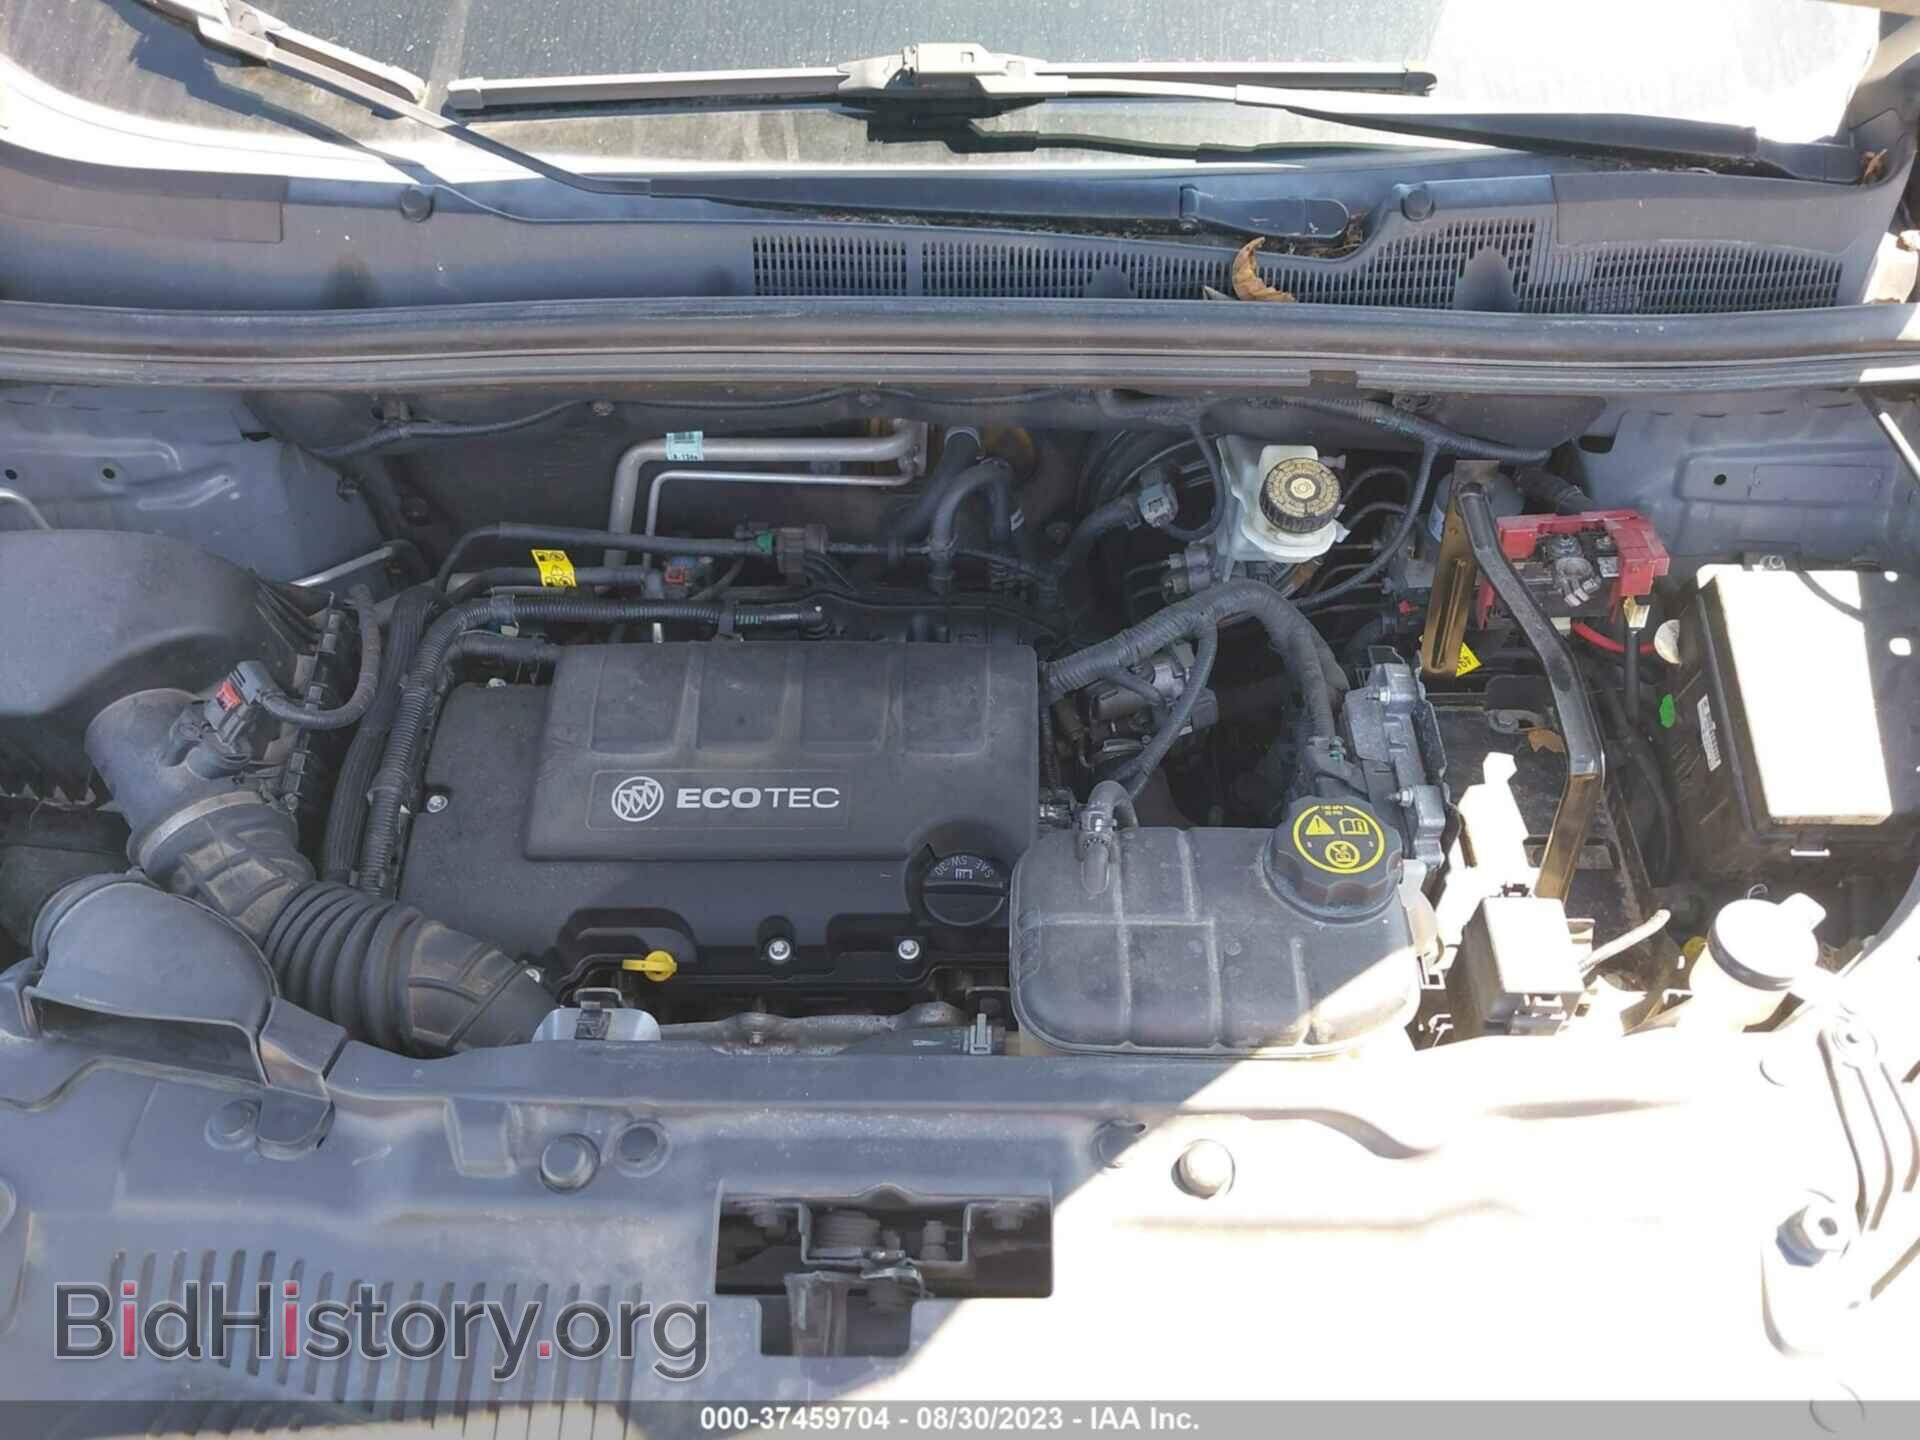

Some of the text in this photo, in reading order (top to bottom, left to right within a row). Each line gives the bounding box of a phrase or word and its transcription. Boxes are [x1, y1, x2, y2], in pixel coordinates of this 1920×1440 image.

[676, 786, 841, 810] ECOTEC
[934, 855, 994, 878] SAE 5W-30
